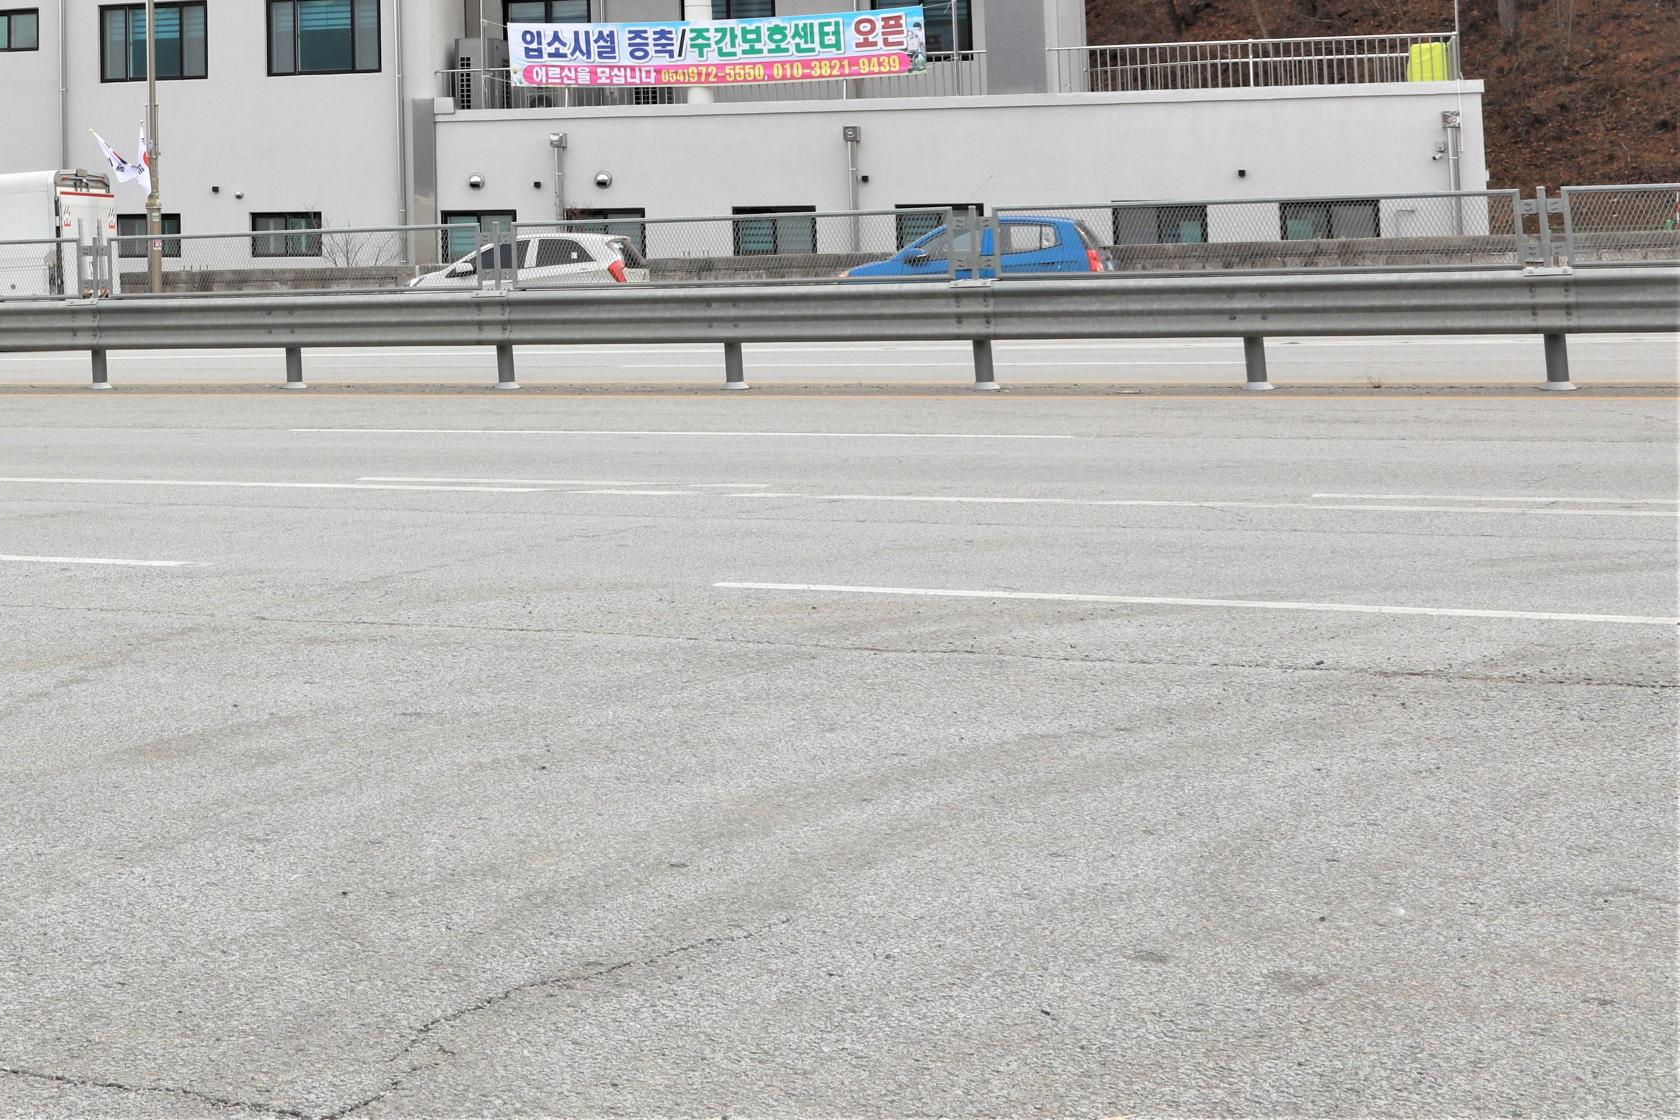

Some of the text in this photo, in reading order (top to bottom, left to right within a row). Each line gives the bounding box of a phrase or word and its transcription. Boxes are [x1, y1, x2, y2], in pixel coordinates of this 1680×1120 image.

[521, 29, 618, 61] 입소시설
[853, 15, 906, 49] 오픈
[532, 66, 591, 86] 어르신을
[596, 65, 657, 84] 모십니다
[773, 55, 901, 80] 010-3821-9439
